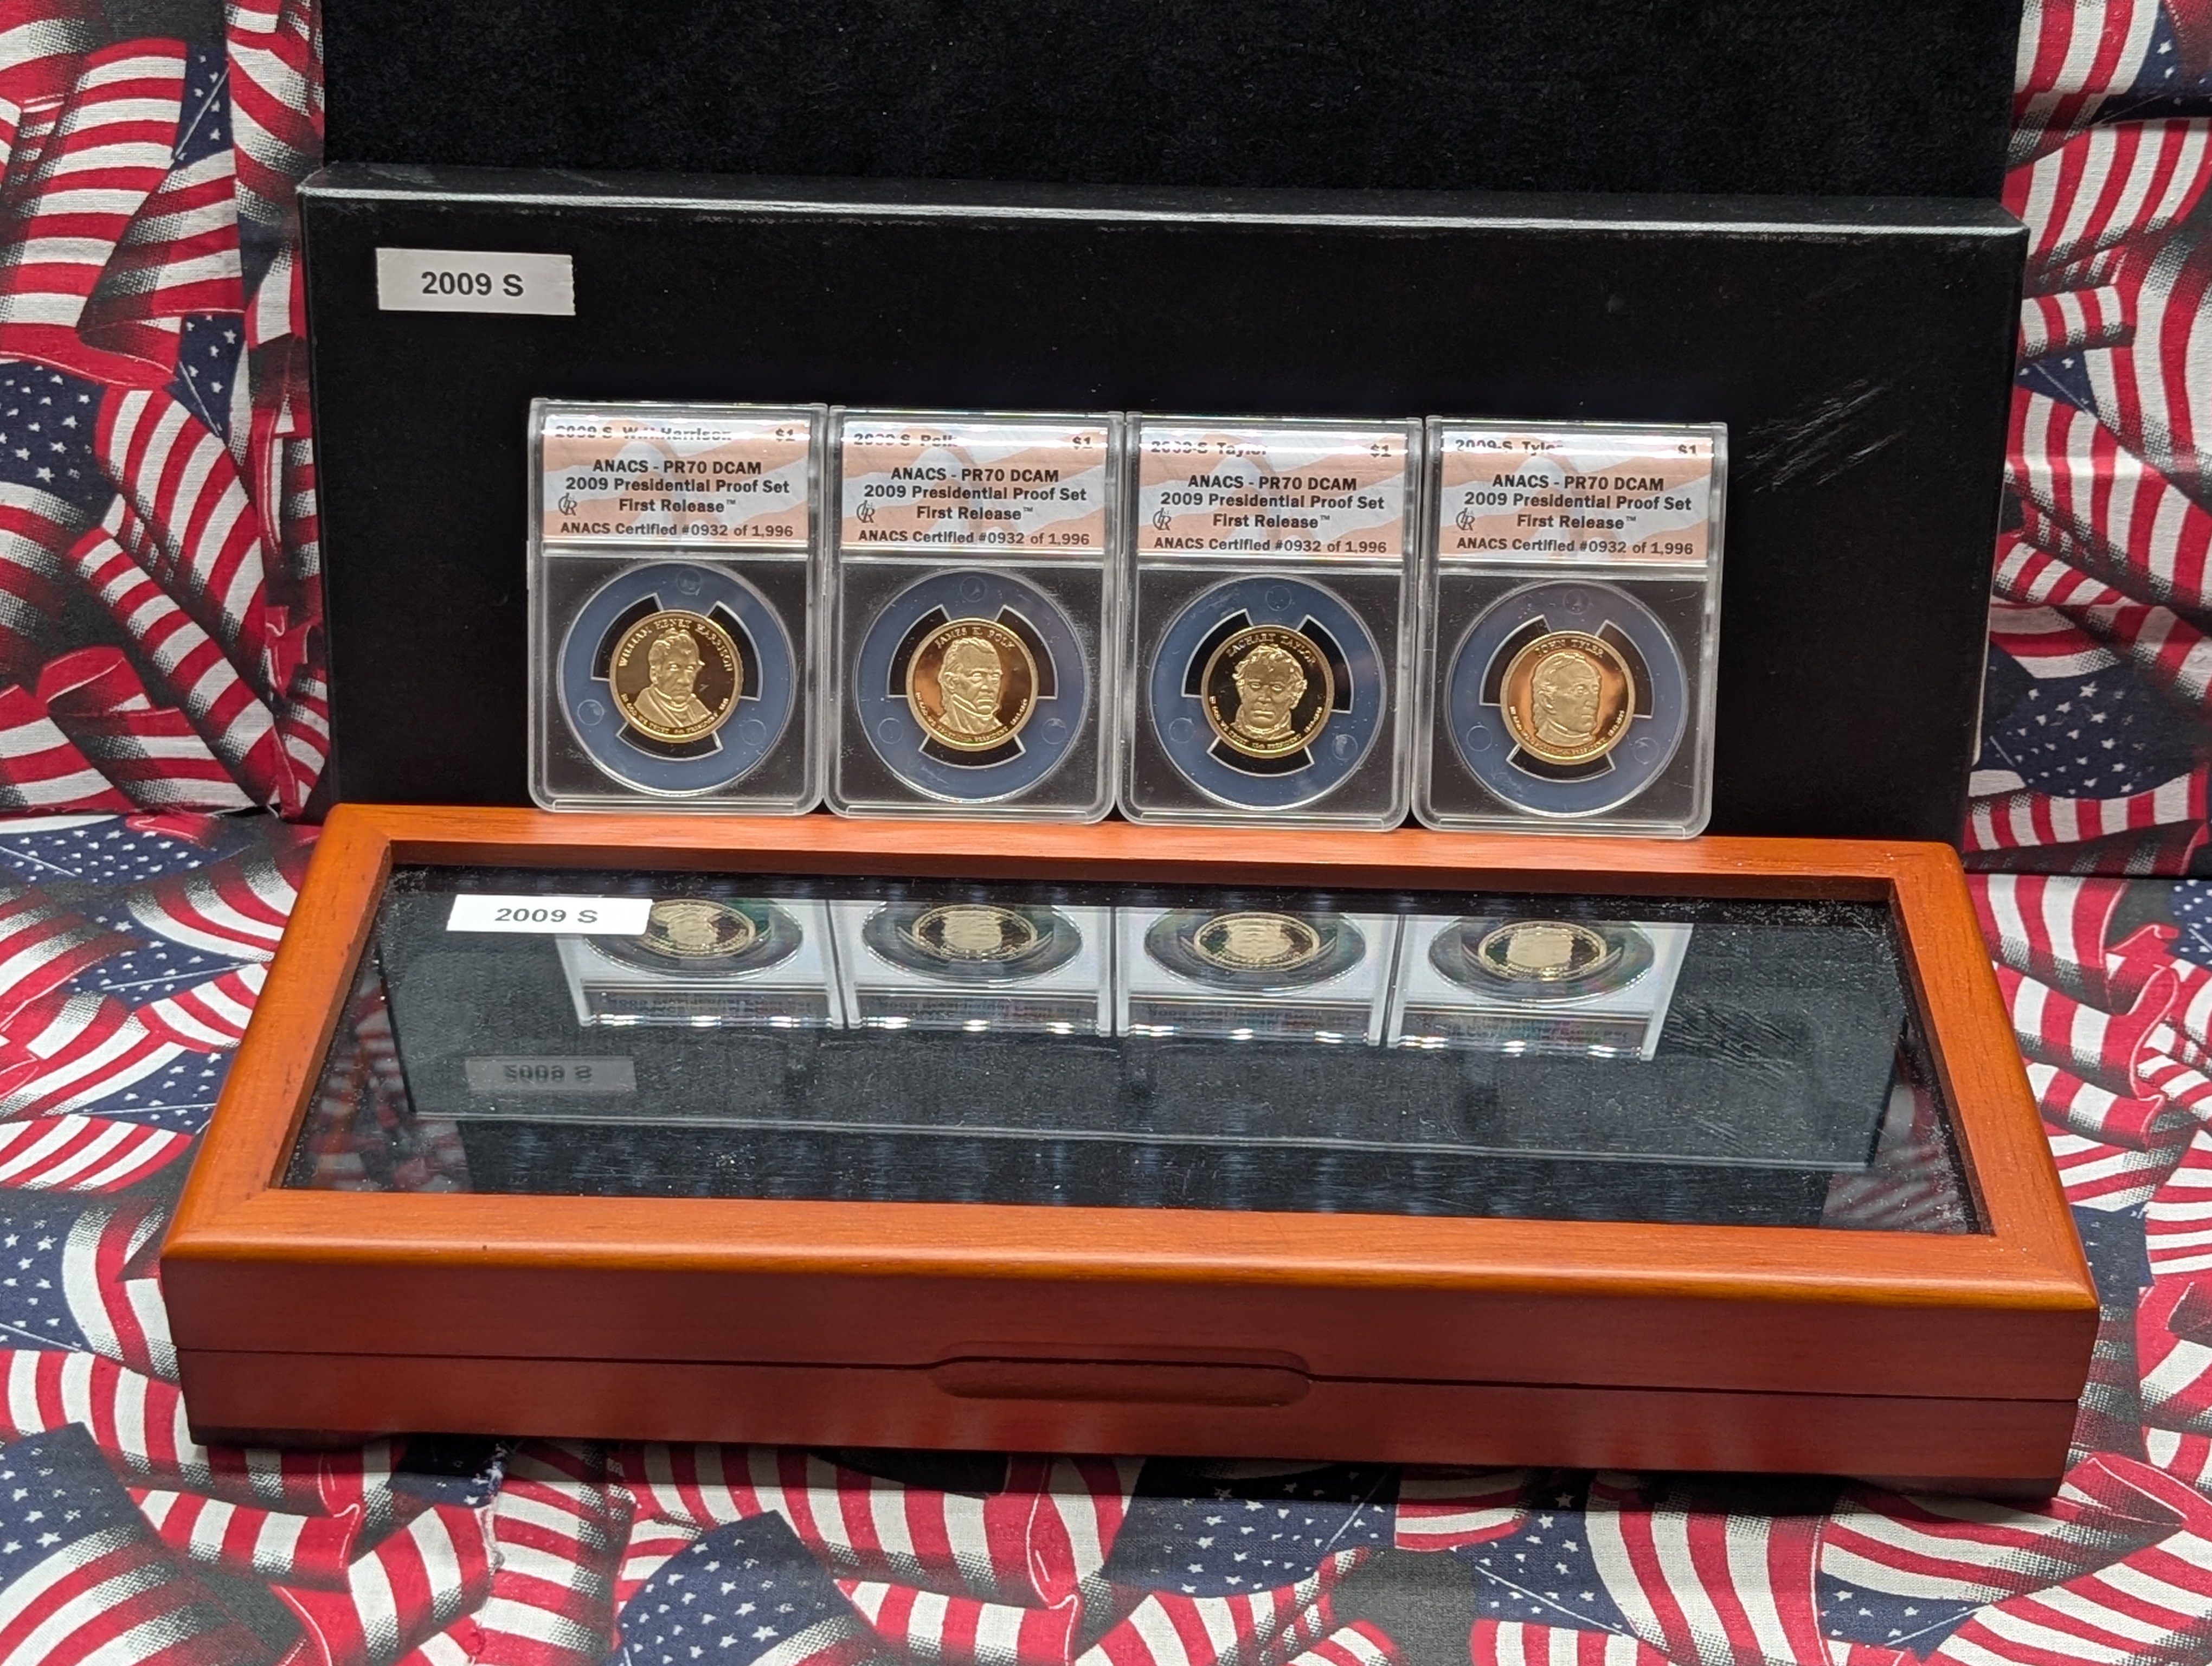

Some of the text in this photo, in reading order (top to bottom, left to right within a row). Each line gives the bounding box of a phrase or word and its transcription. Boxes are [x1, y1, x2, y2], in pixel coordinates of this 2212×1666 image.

[421, 271, 524, 297] 2009 S
[592, 459, 649, 473] ANACS
[663, 460, 707, 475] PR70
[712, 460, 762, 475] DCAM
[890, 466, 947, 482] ANACS
[961, 468, 1005, 482] PR70
[1010, 469, 1059, 483] DCAM
[565, 476, 790, 494] 2009 Presidential Proof Set
[1187, 474, 1244, 489] ANACS
[1258, 476, 1303, 490] PR70
[1307, 477, 1357, 491] DCAM
[1491, 473, 1549, 489] ANACS
[1564, 475, 1609, 490] PR70
[1613, 477, 1664, 492] DCAM
[863, 484, 1087, 501] 2009 Presidential Proof Set
[1160, 491, 1385, 510] 2009 Presidential Proof Set
[1463, 491, 1692, 511] 2009 Presidential Proof Set
[619, 497, 657, 512] First
[916, 505, 954, 520] First
[1212, 512, 1250, 528] First
[1516, 513, 1554, 528] First
[560, 522, 794, 539] ANACS Certified #0932 of 1,996
[858, 529, 909, 542] ANACS
[912, 530, 975, 544] Certified
[976, 530, 1025, 546] #0932
[1030, 532, 1045, 545] of
[1153, 536, 1205, 550] ANACS
[1208, 537, 1271, 552] Certified
[1274, 539, 1322, 553] #0932
[1327, 540, 1342, 553] of
[1456, 537, 1694, 556] ANACS Certified #0932 of 1,996
[495, 908, 598, 923] 2009 S
